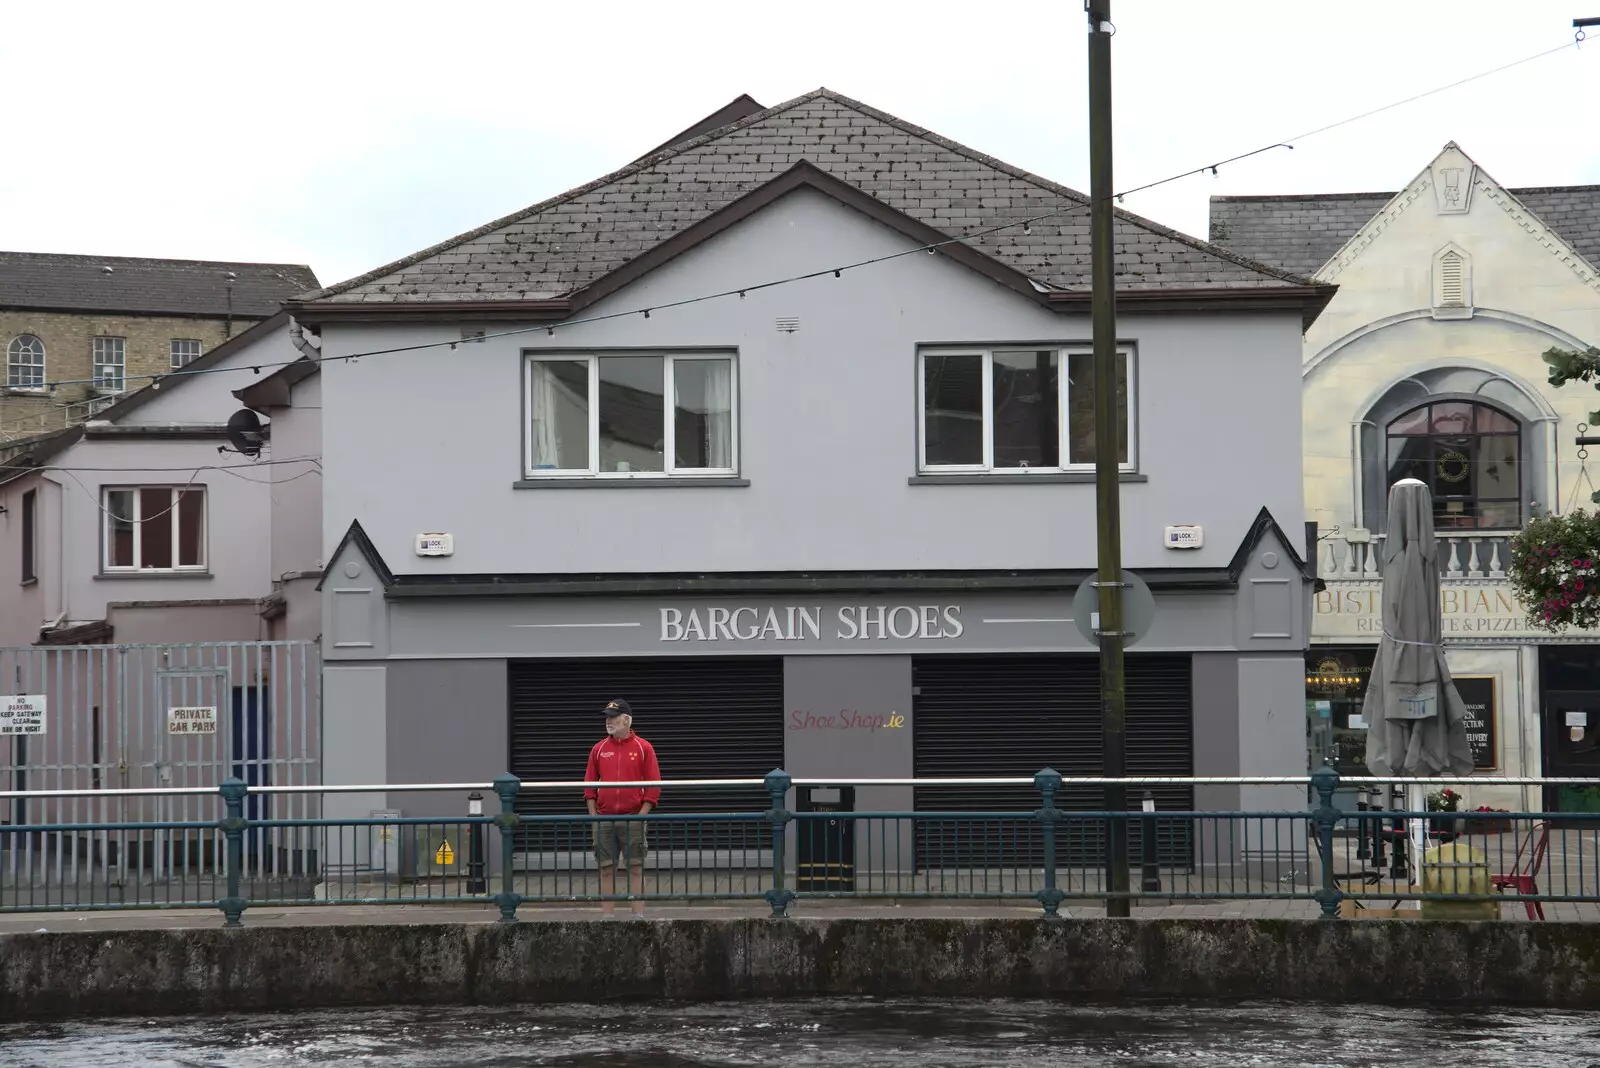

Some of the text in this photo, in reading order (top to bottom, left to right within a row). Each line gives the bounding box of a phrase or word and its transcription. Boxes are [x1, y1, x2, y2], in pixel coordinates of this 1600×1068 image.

[1316, 590, 1381, 615] BIST
[659, 605, 965, 642] BARGAIN SHOES
[1463, 618, 1473, 631] &
[1477, 618, 1538, 632] PIZZER
[174, 709, 212, 720] PRIVATE
[170, 721, 216, 732] CAR PARK
[1463, 720, 1484, 728] ECTION
[1466, 733, 1488, 742] ELIVERY
